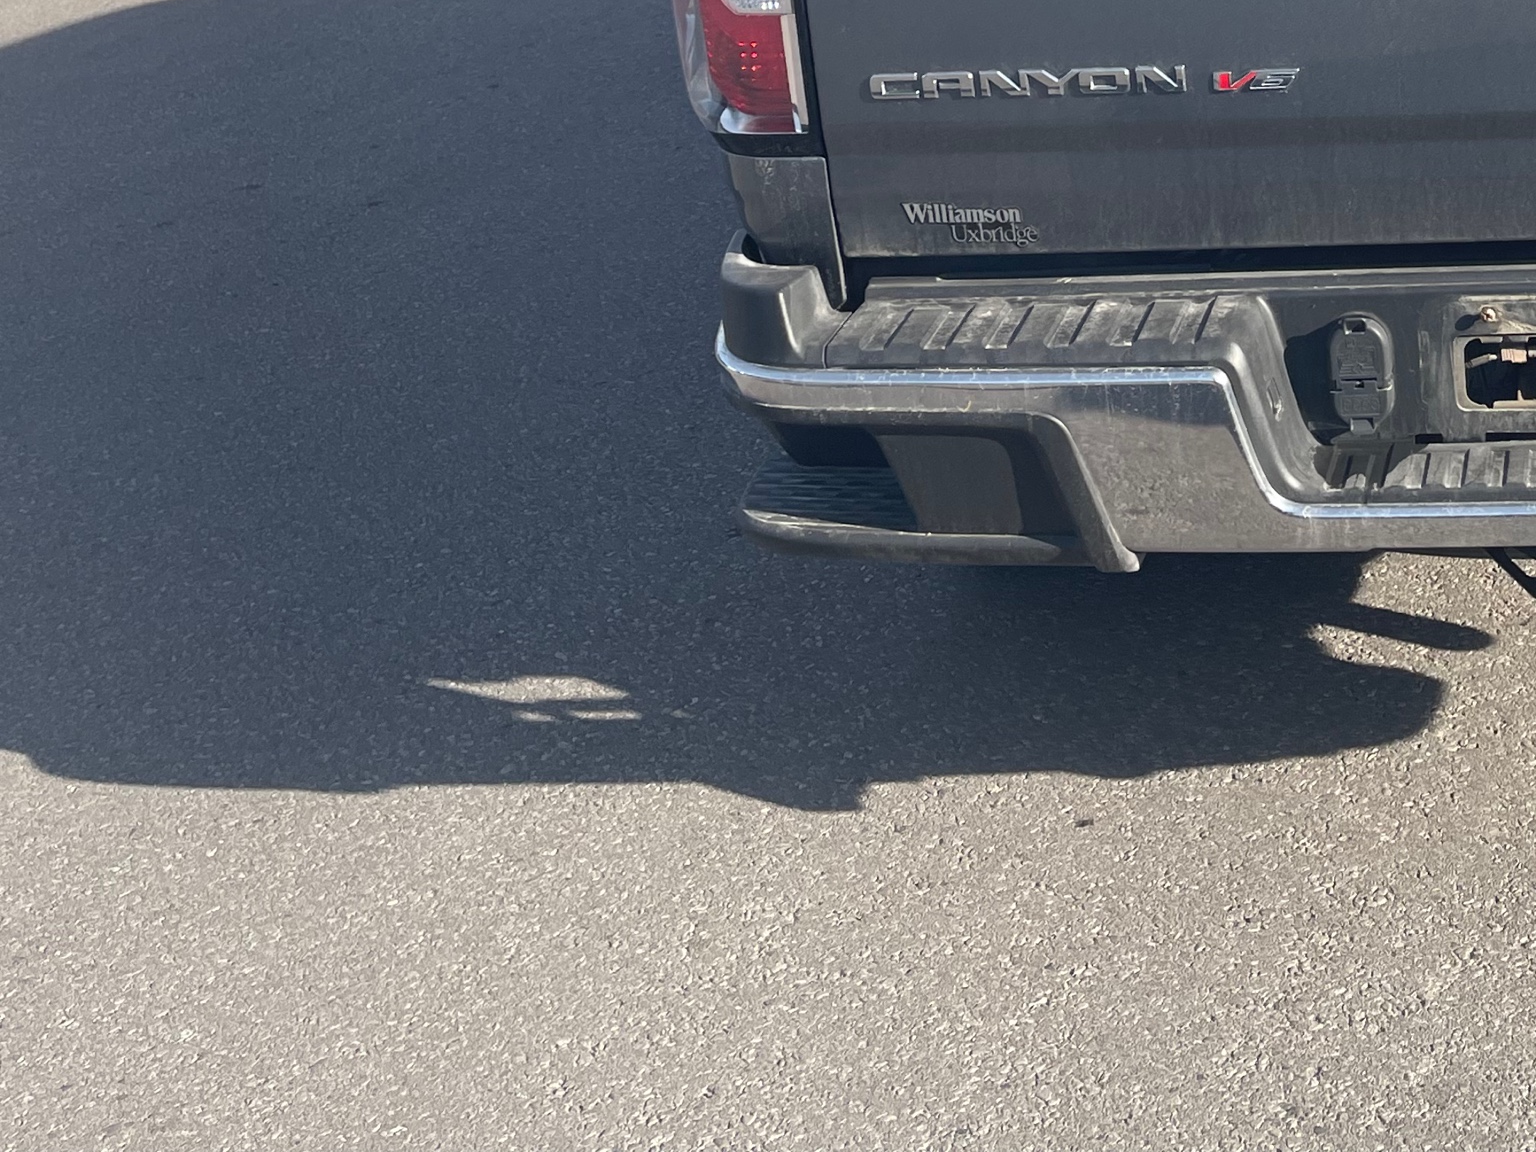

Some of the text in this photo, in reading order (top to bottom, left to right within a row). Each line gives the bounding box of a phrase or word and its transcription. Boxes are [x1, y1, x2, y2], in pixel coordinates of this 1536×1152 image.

[869, 64, 1300, 100] CANYON V6
[901, 202, 1022, 224] Williamson
[950, 223, 1040, 247] Uxbridge
